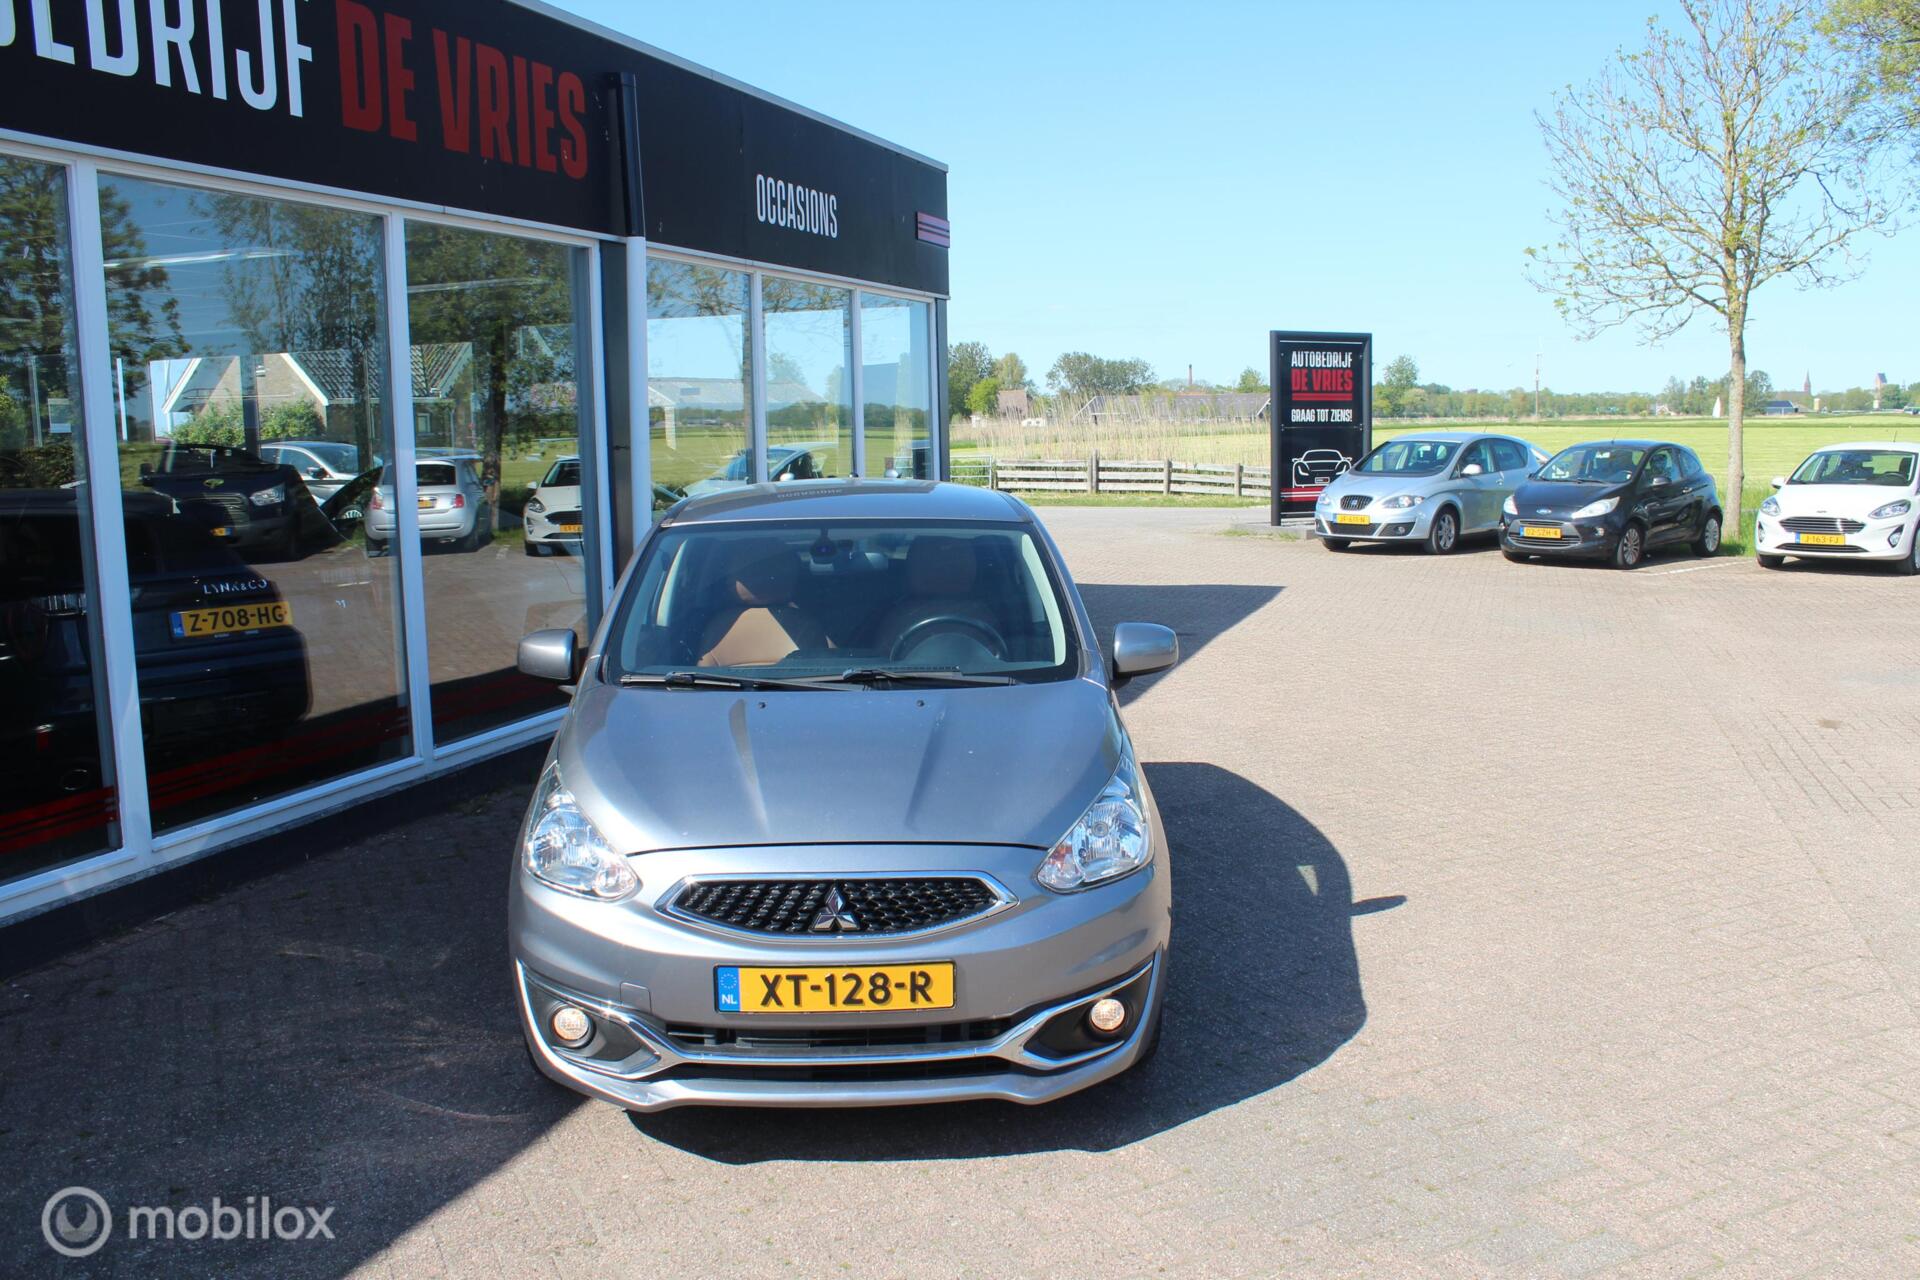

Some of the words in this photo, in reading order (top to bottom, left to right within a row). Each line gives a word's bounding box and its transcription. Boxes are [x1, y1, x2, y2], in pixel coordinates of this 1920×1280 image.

[335, 0, 417, 142] DE
[432, 28, 588, 180] VRIES
[756, 173, 838, 239] OCCASIONS
[1291, 351, 1353, 369] AUTOBEDRIJF
[1291, 368, 1308, 391] DE
[1312, 369, 1354, 391] VRIES
[1291, 408, 1316, 423] GRAAG
[1316, 408, 1330, 423] TOT
[1330, 408, 1353, 423] ZIENS!
[188, 604, 286, 632] Z-708-HG
[721, 994, 738, 1005] NL
[760, 971, 933, 1007] XT-128-R
